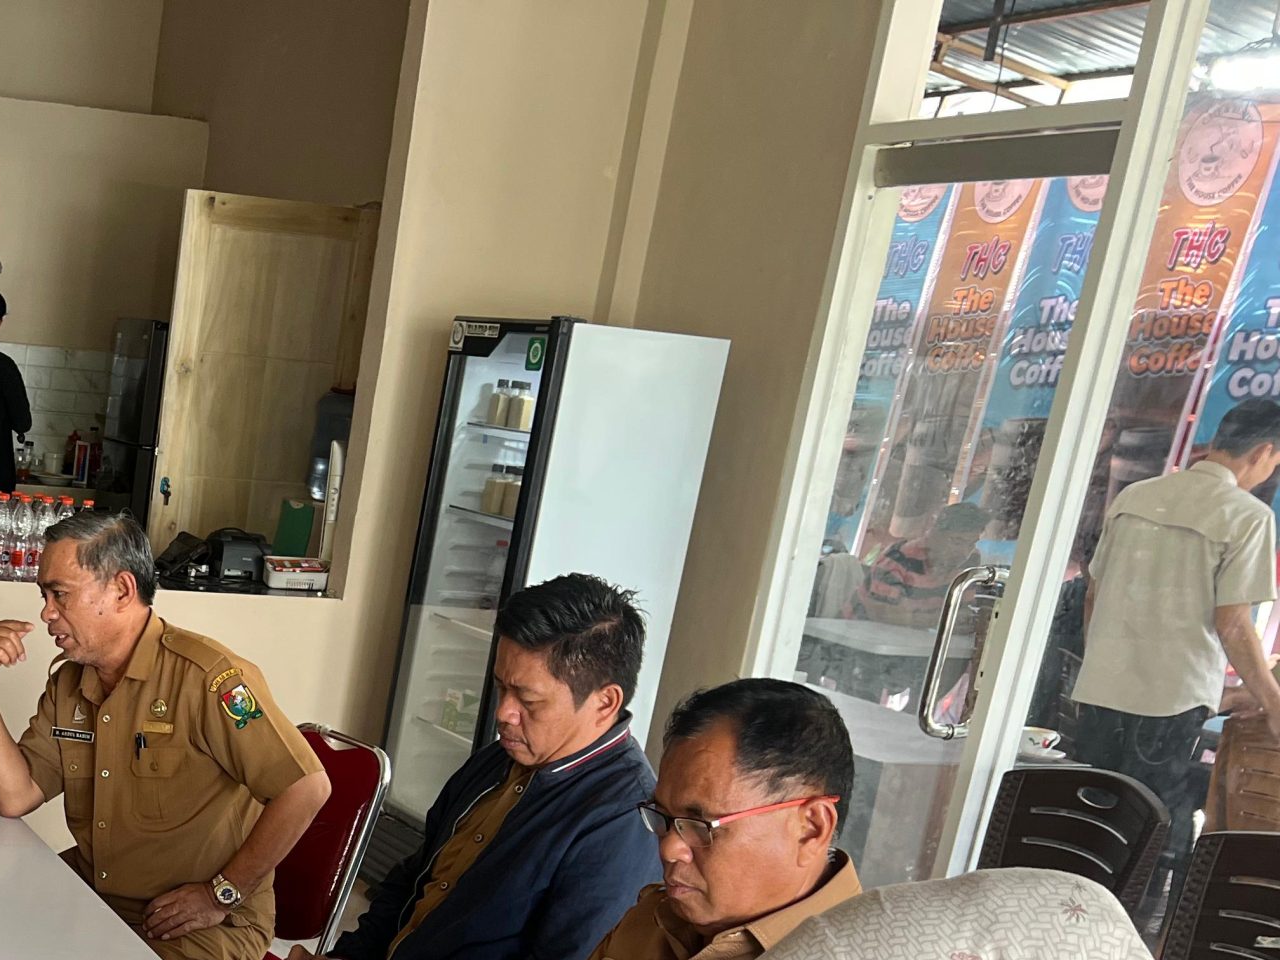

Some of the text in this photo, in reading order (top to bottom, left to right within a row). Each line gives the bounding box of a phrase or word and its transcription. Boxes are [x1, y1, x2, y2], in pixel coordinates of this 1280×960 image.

[959, 234, 1011, 281] THC
[1167, 220, 1231, 272] THC
[873, 297, 911, 324] The
[951, 284, 995, 317] The
[1157, 276, 1213, 312] The
[867, 325, 913, 349] ouse
[926, 314, 999, 345] House
[1129, 310, 1218, 343] House
